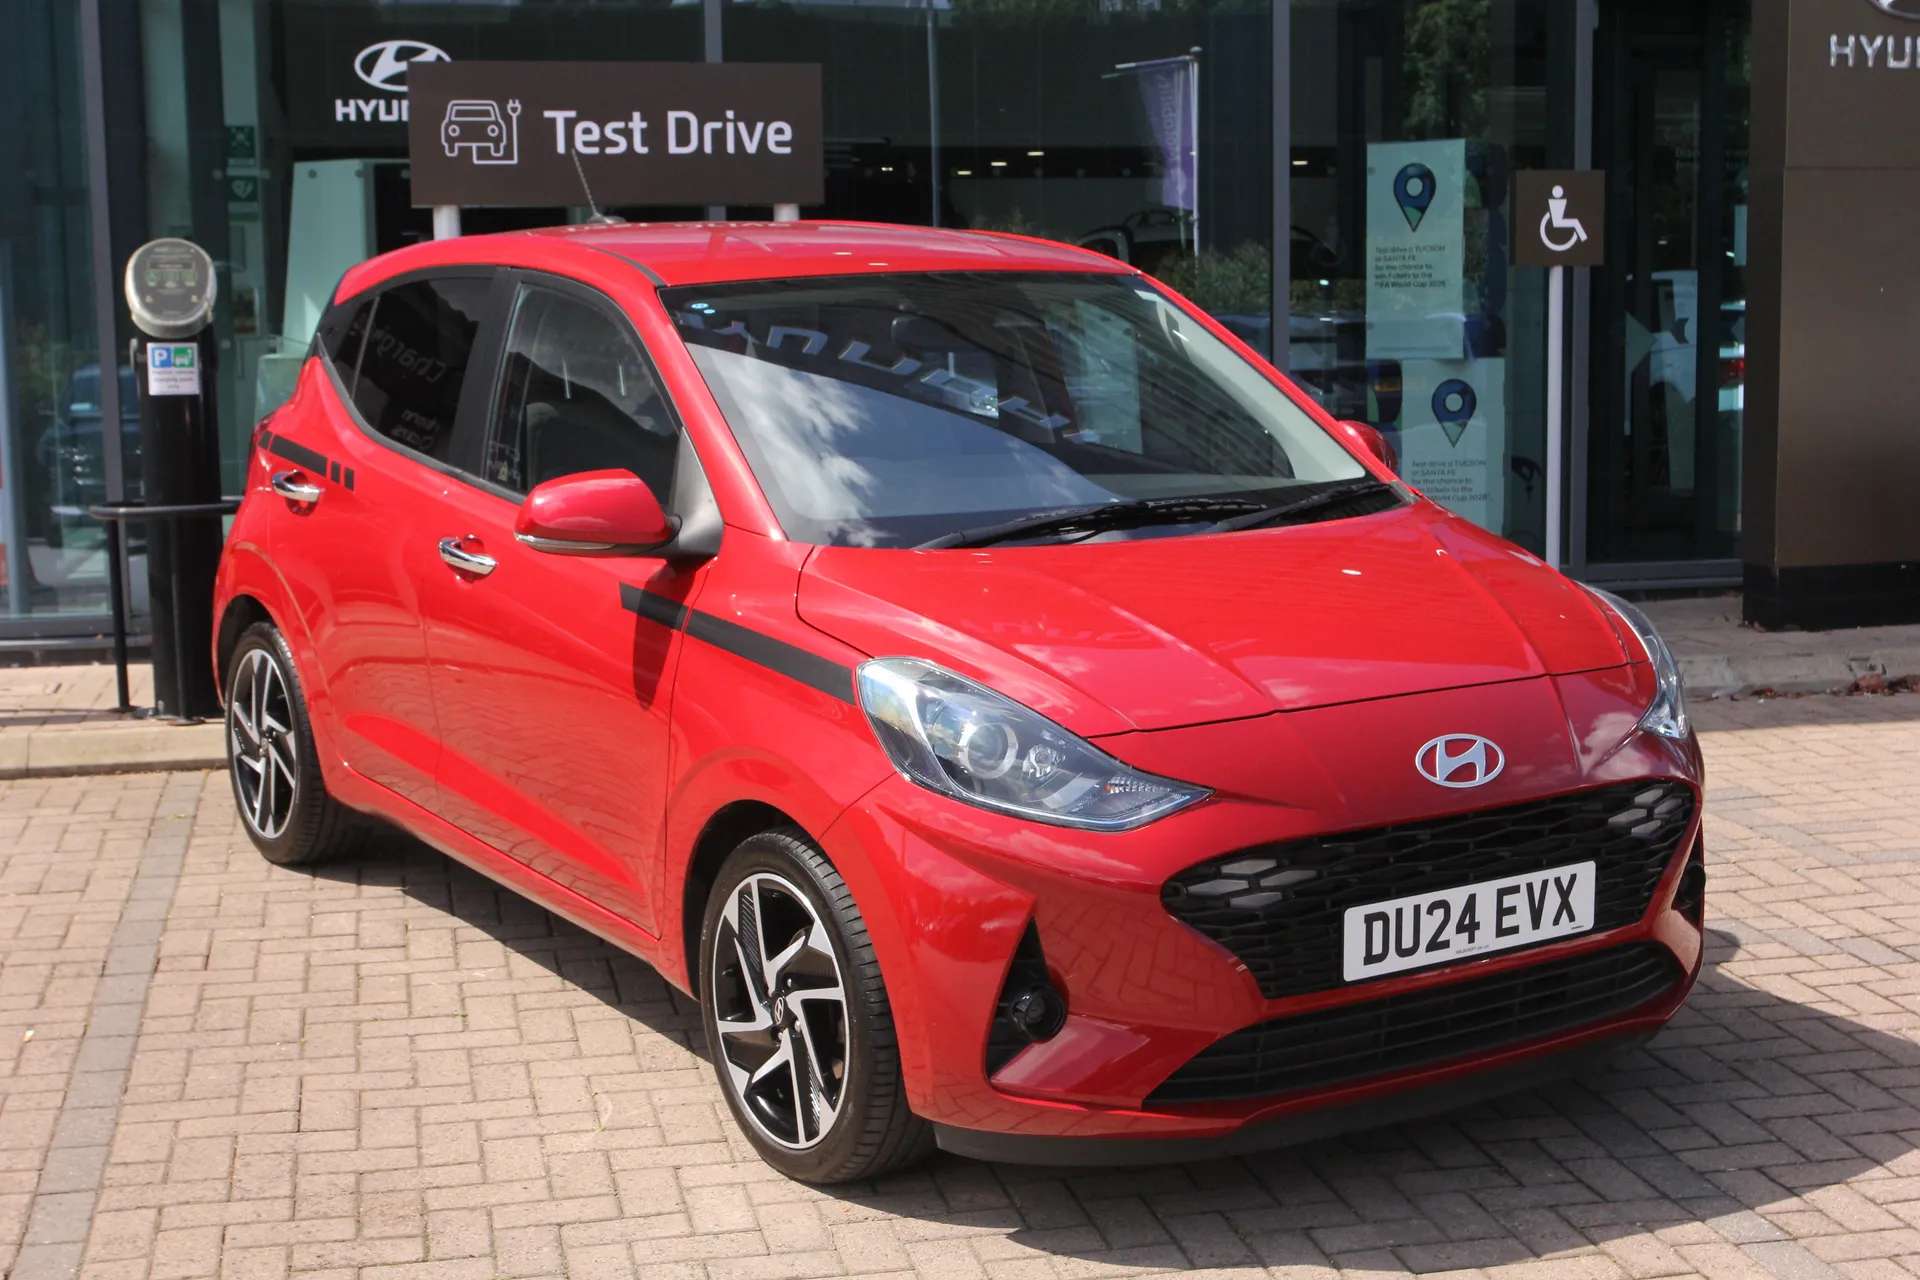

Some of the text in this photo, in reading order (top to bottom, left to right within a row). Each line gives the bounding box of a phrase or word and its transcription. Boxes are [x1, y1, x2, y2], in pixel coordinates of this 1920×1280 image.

[543, 109, 793, 155] Test Drive
[154, 349, 168, 366] P
[1363, 873, 1578, 966] DU24 EVX
